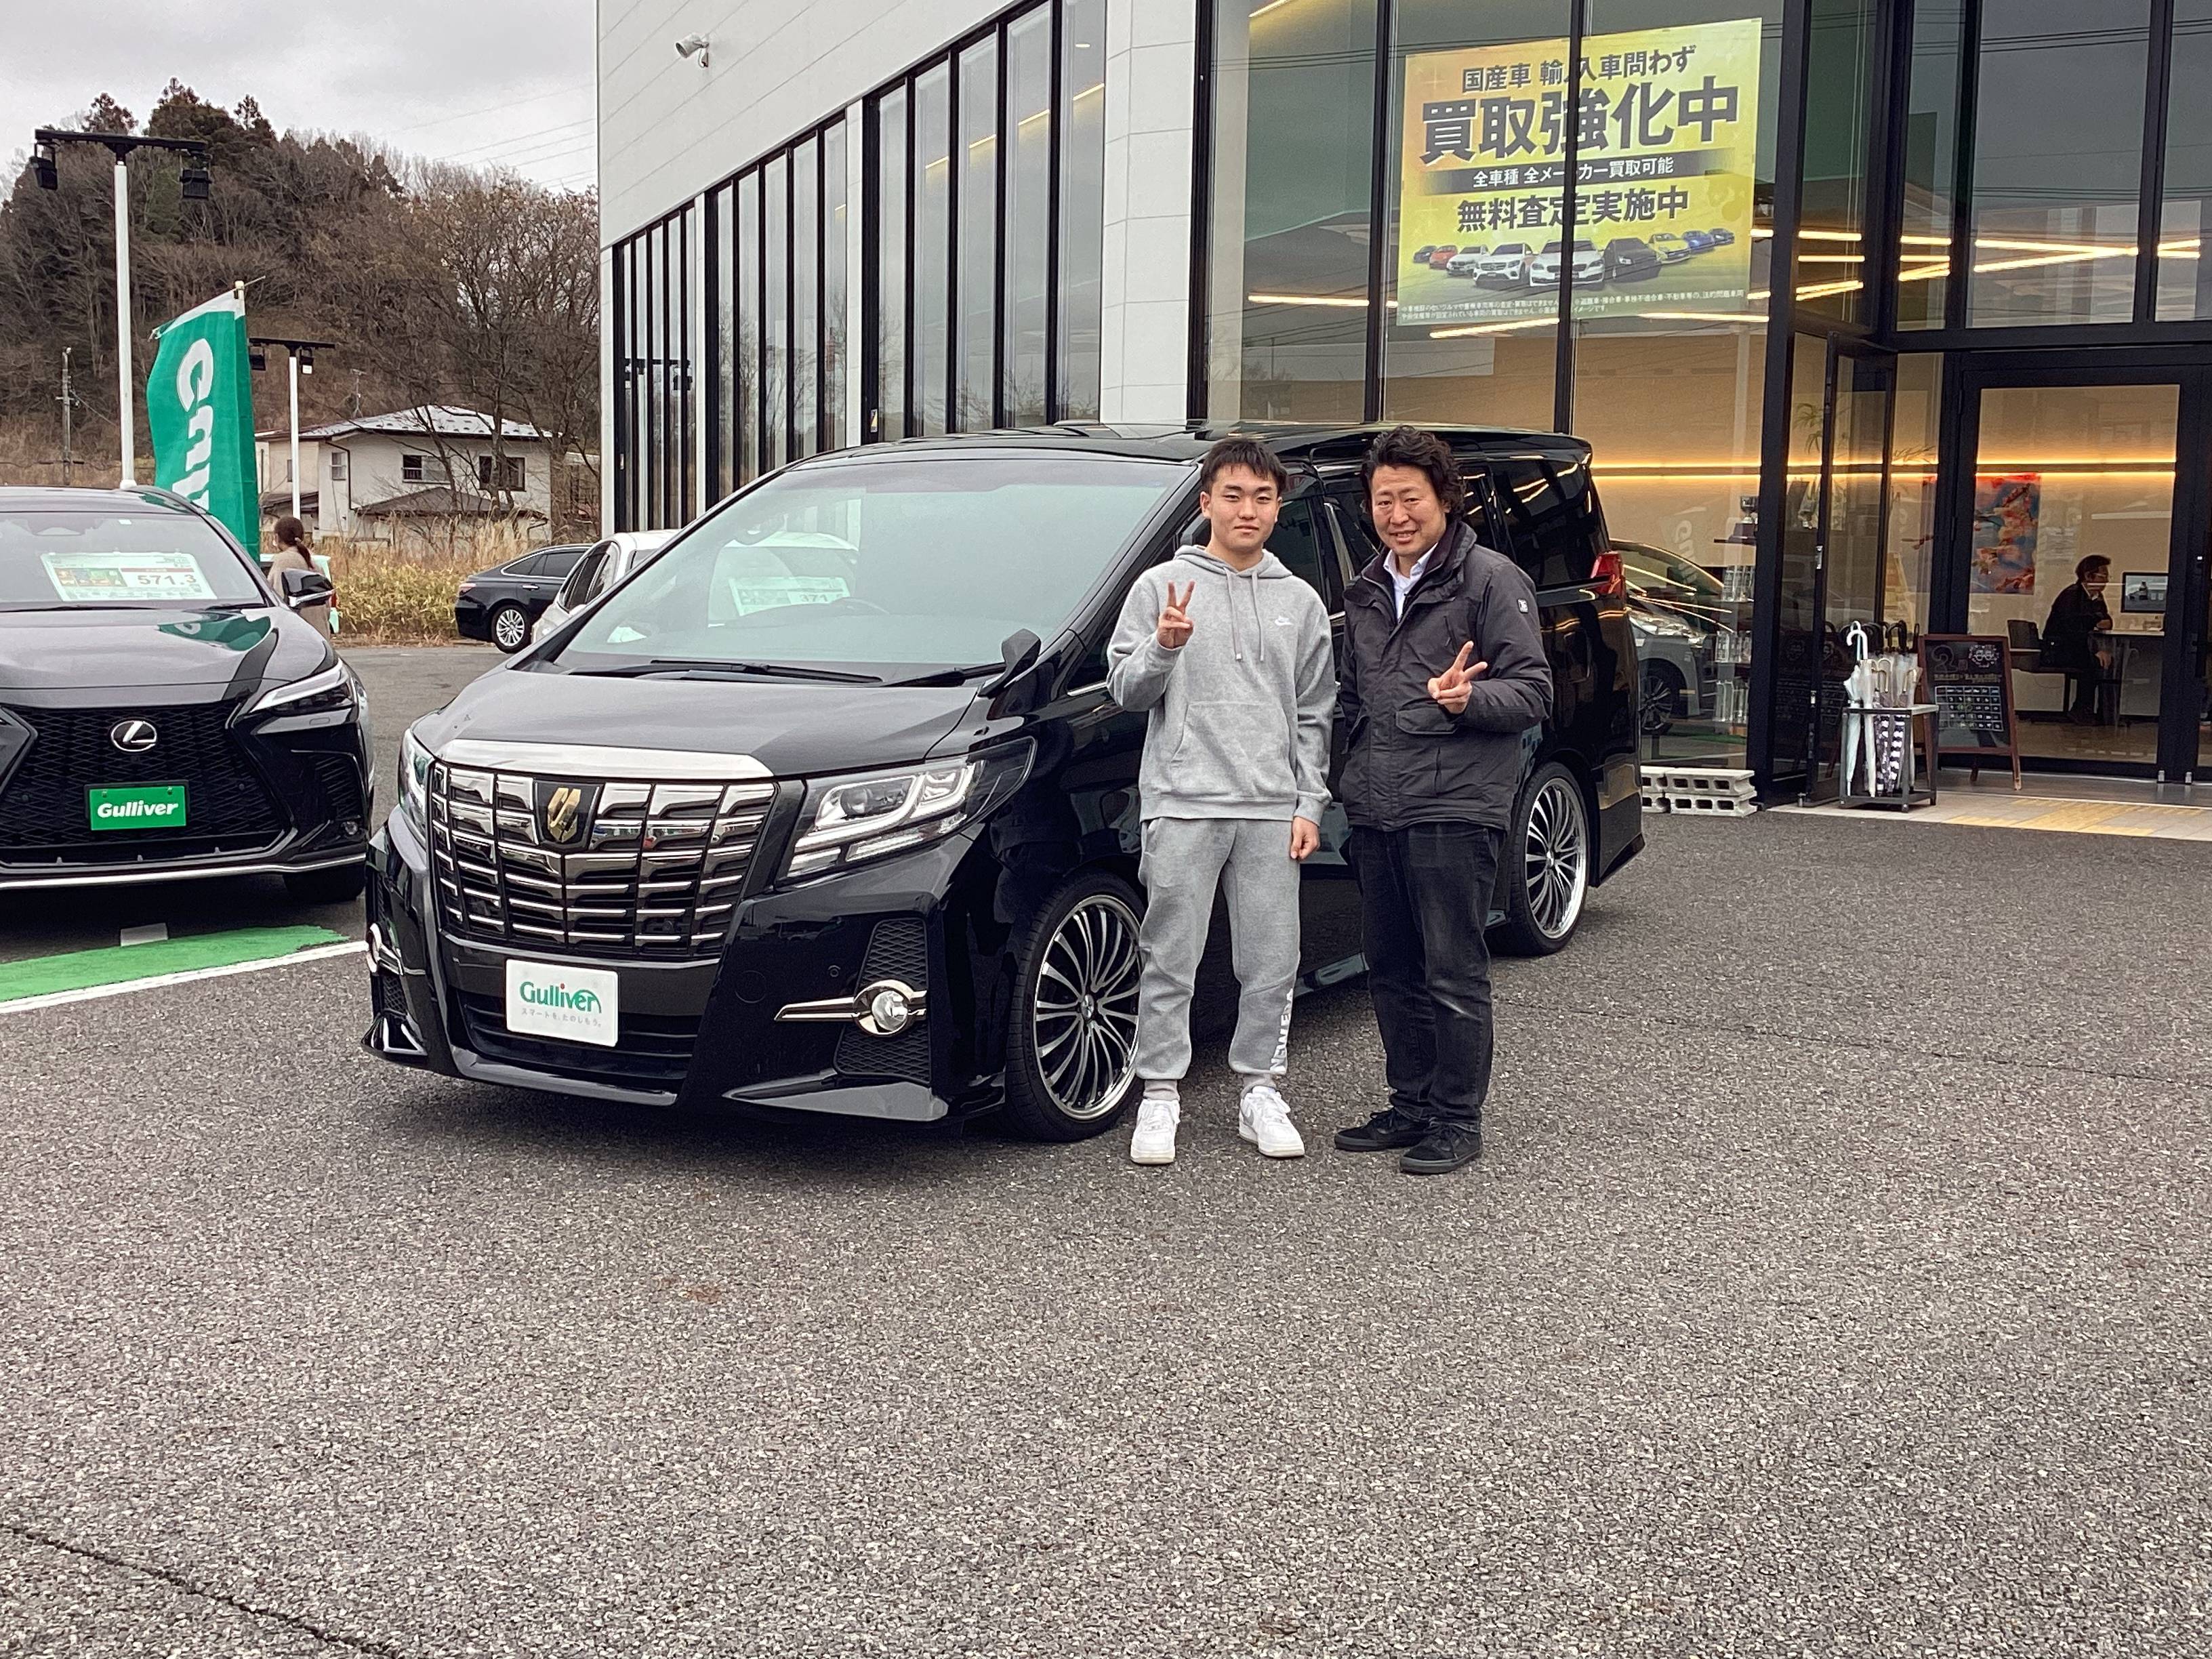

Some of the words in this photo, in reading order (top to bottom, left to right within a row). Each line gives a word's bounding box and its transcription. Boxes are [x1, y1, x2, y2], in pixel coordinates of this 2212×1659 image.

[1462, 63, 1531, 93] 国産車
[1539, 45, 1696, 85] 輸入車問わず
[1420, 75, 1738, 163] 買取強化中
[1473, 168, 1519, 188] 全車種
[1524, 157, 1673, 184] 全メーカー買取可能
[1458, 185, 1688, 232] 無料査定実施中
[137, 575, 197, 586] 571.3
[97, 800, 179, 818] Gulliver
[520, 981, 602, 1014] Gulliver
